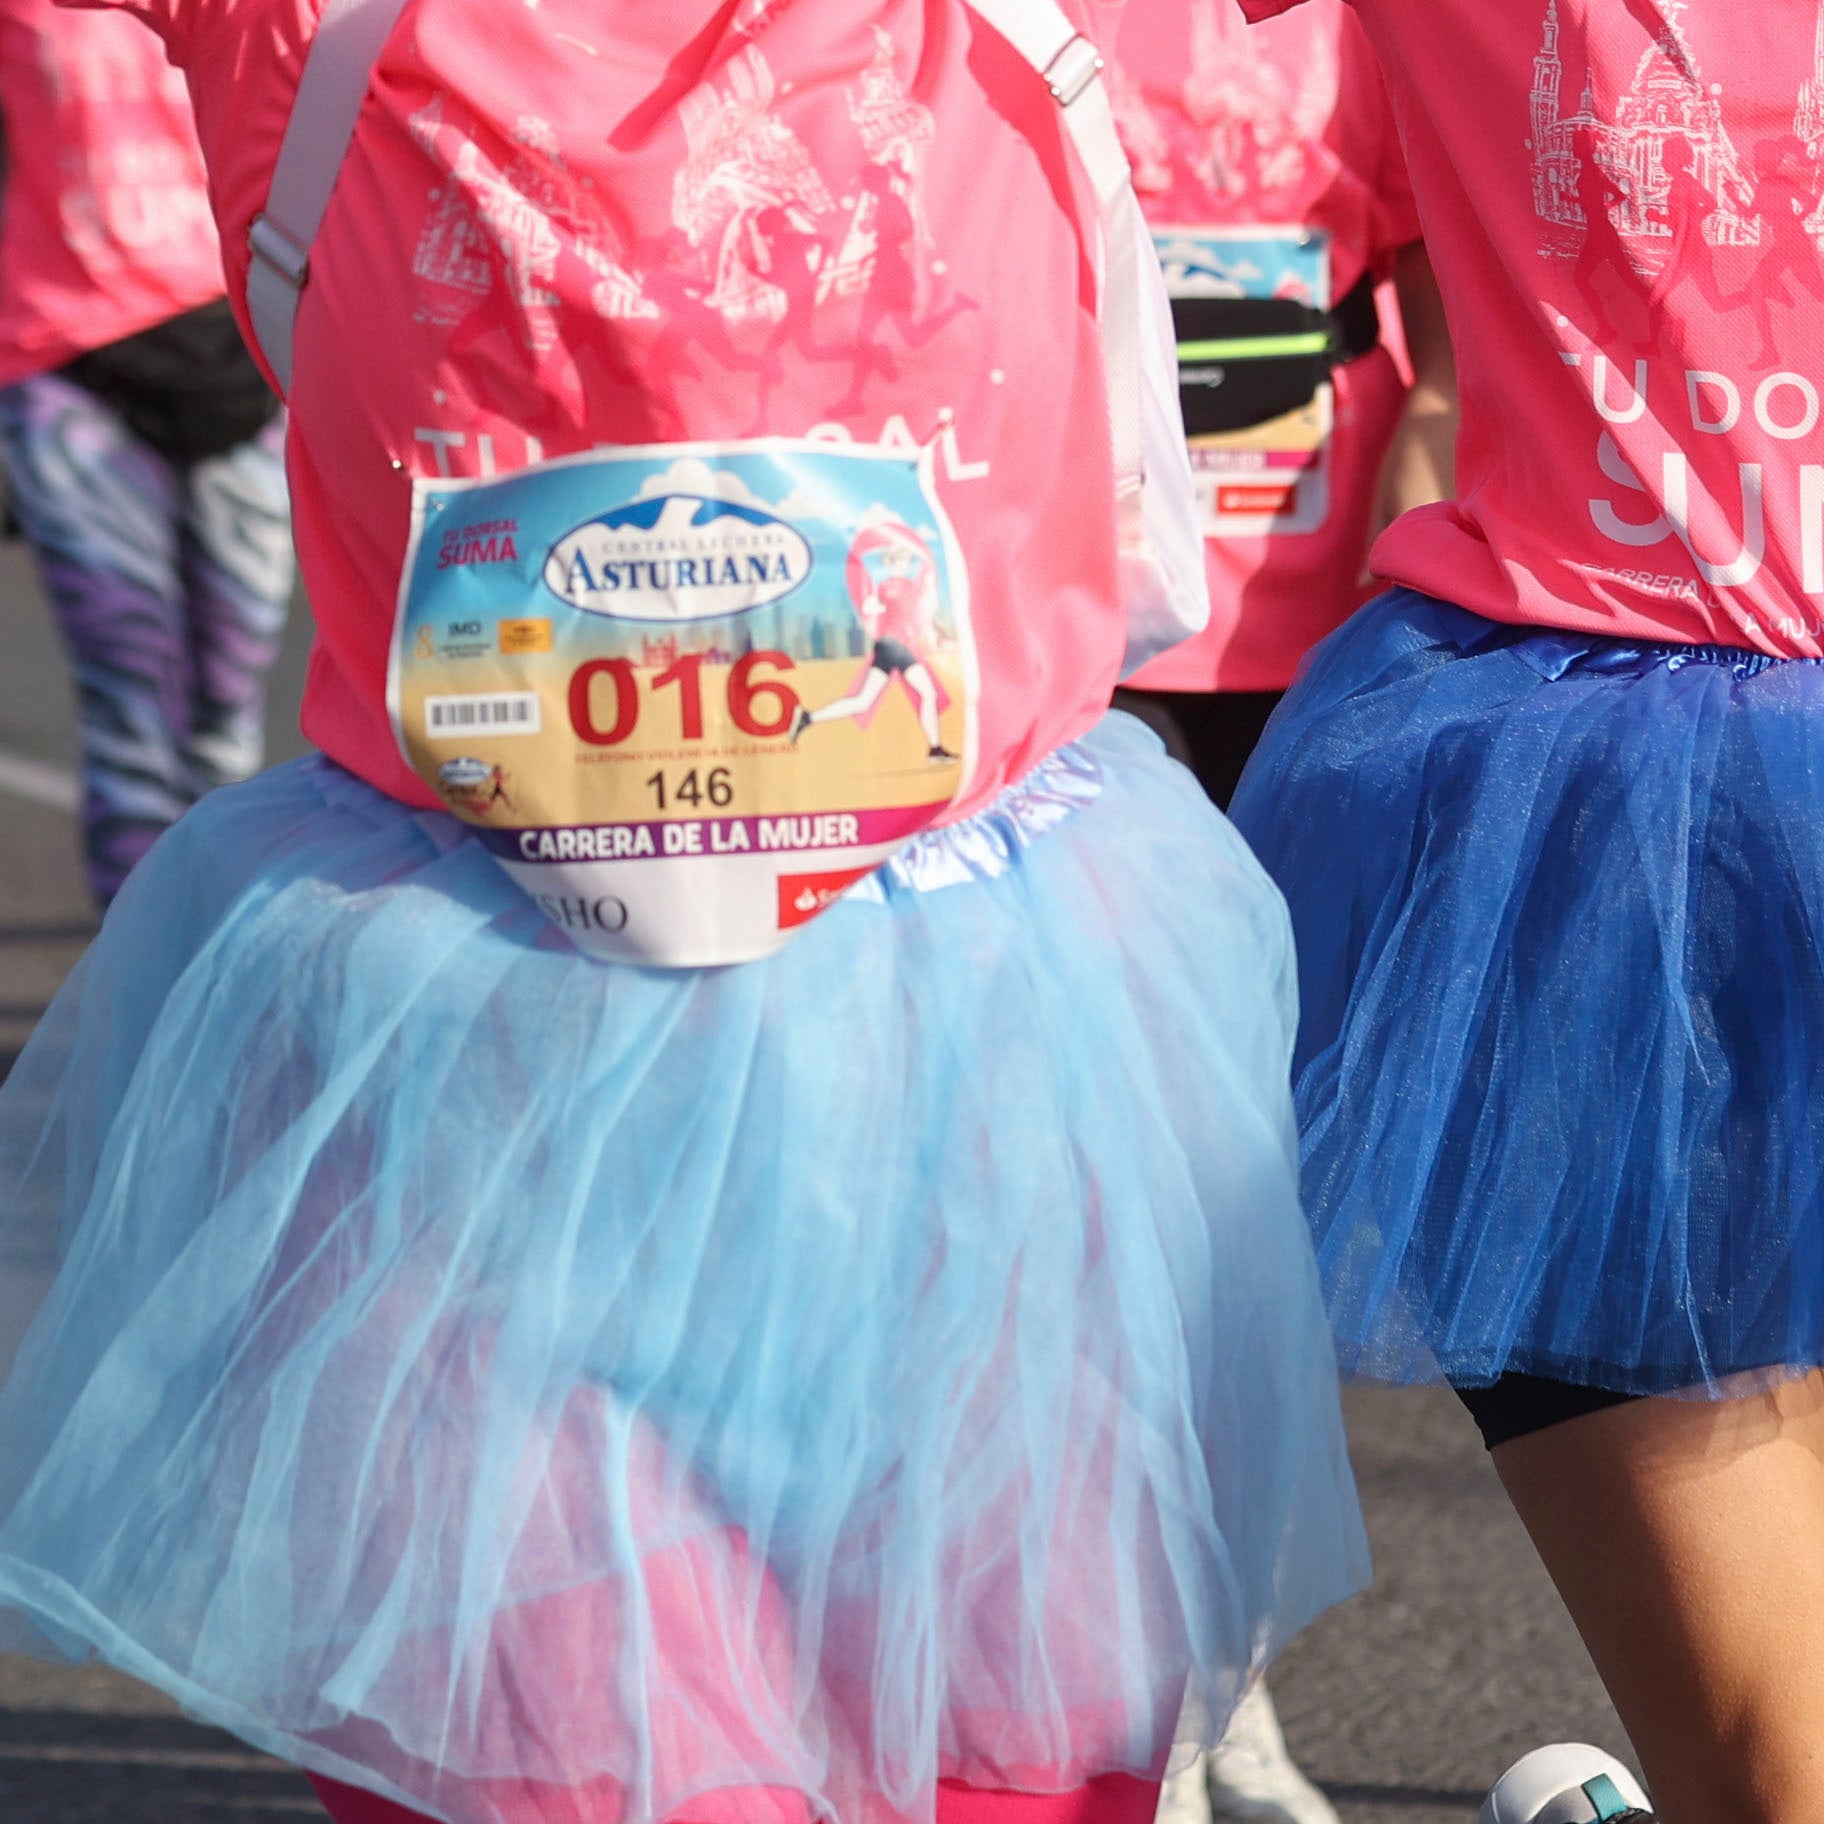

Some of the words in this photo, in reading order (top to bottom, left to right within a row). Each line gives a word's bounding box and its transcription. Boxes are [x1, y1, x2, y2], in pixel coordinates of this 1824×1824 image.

[1559, 351, 1647, 424] U
[437, 535, 518, 571] SUMA
[565, 545, 792, 593] ASTURIANA
[568, 650, 801, 746] 016
[647, 767, 733, 810] 146
[519, 826, 655, 861] CARRERA
[663, 822, 703, 855] DE
[711, 820, 749, 851] LA
[758, 814, 859, 849] MUJER
